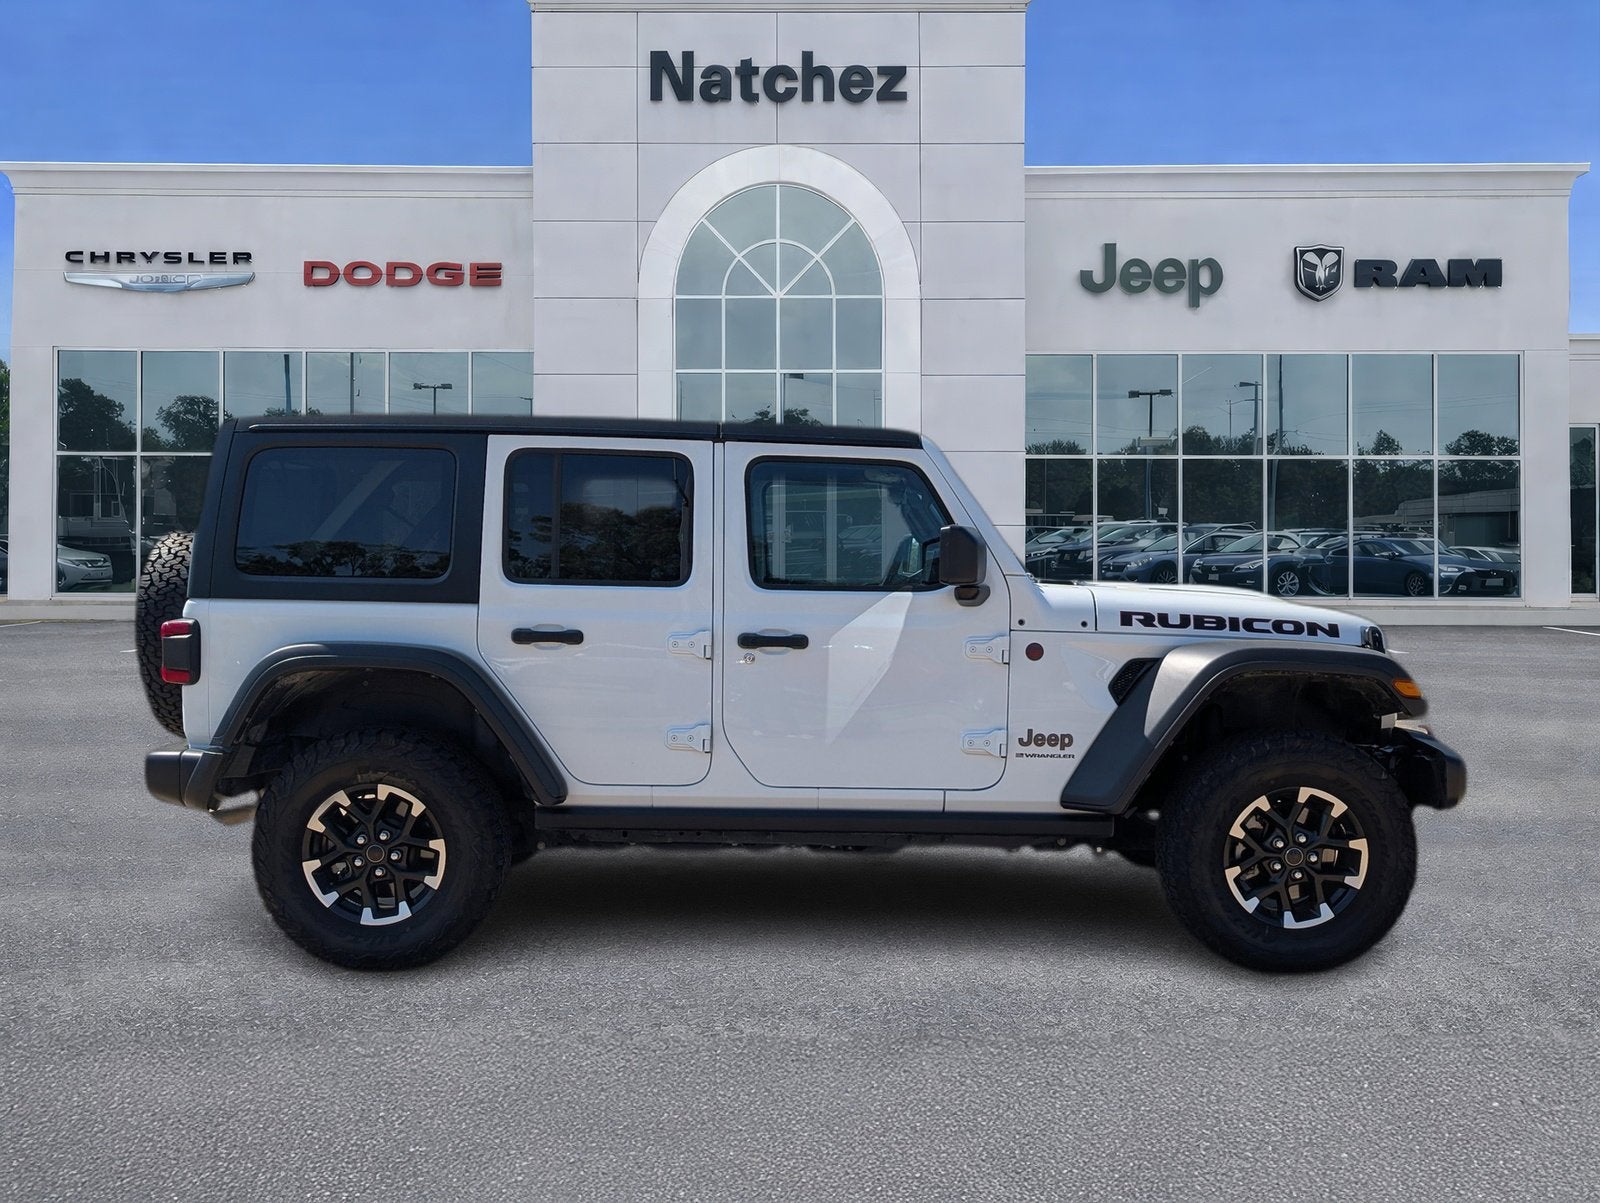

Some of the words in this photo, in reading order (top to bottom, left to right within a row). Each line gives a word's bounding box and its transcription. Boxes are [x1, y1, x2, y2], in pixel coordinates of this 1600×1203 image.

[650, 50, 908, 103] Natchez
[65, 251, 252, 264] CHRYSLER
[303, 261, 502, 287] DODGE
[1080, 243, 1224, 309] Jeep
[1354, 258, 1503, 288] RAM
[1119, 610, 1340, 638] RUBICON
[1018, 728, 1074, 751] Jeep
